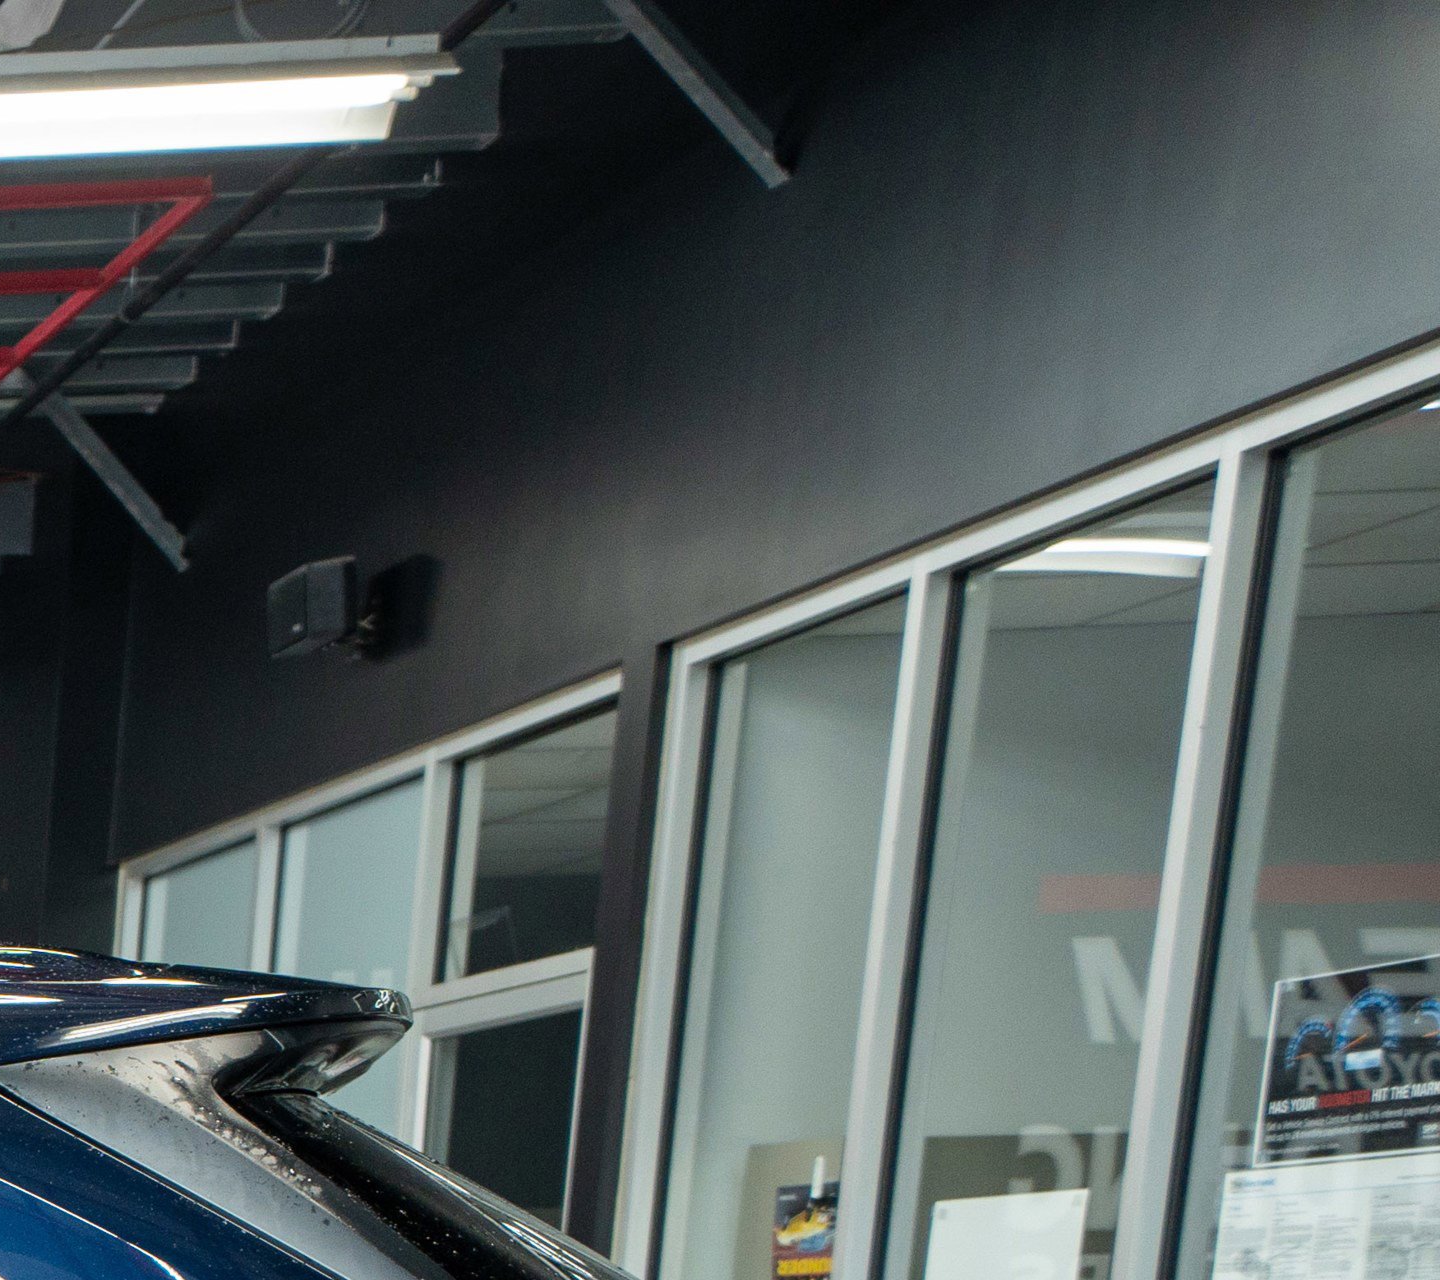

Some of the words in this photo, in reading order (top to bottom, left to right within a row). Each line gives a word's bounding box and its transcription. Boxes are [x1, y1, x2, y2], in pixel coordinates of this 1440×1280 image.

[1268, 1100, 1290, 1114] HAS
[1291, 1096, 1317, 1113] YOUR
[1371, 1086, 1390, 1102] HIT
[1391, 1084, 1412, 1100] THE
